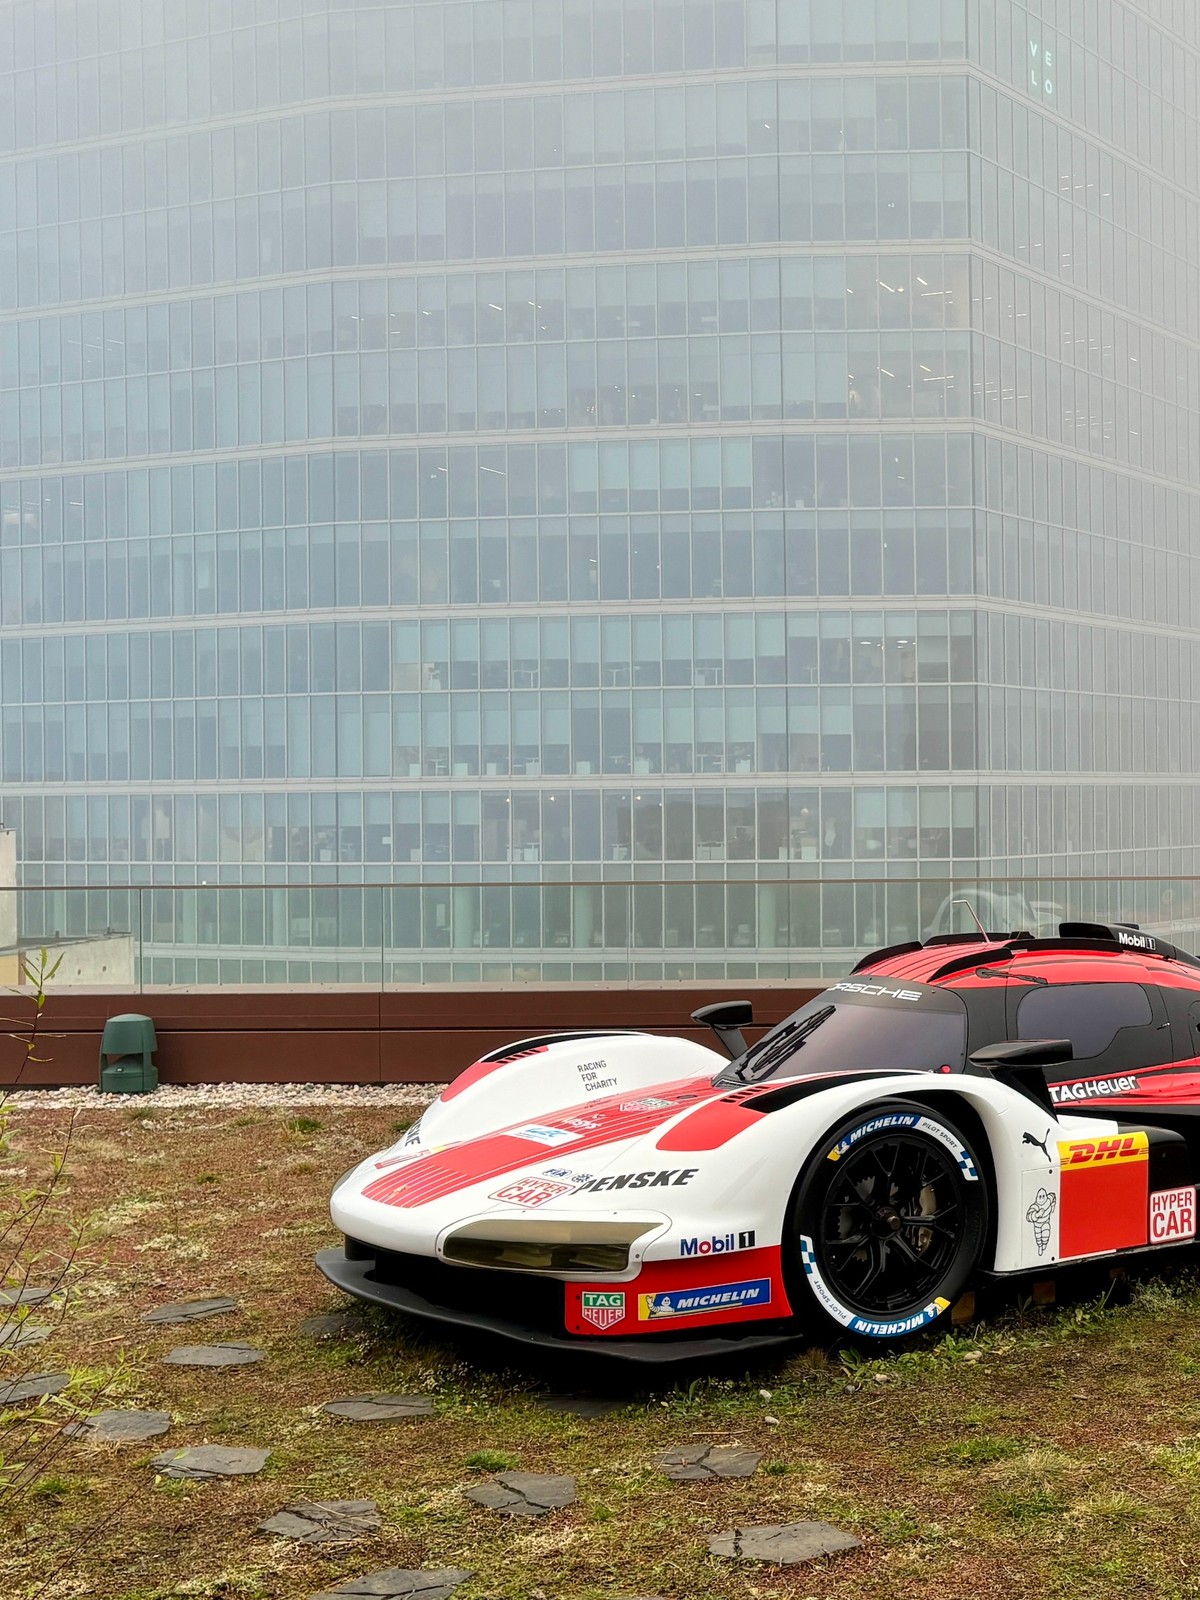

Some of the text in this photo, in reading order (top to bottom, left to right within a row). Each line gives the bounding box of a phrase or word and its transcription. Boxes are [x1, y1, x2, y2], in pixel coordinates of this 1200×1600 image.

[1118, 932, 1146, 948] Mobil
[577, 1060, 608, 1073] RACING
[581, 1072, 598, 1083] FOR
[585, 1077, 619, 1092] CHARITY
[850, 1115, 958, 1149] MICHELIN PILOT SPORT
[1068, 1137, 1141, 1164] DHL
[516, 1178, 568, 1195] HYPER
[569, 1168, 700, 1196] PENSKE
[496, 1185, 550, 1206] CAR
[1152, 1191, 1192, 1213] HYPER
[1152, 1207, 1192, 1238] CAR
[680, 1233, 735, 1256] Mobil
[586, 1294, 622, 1306] TAG
[676, 1287, 760, 1309] MICHELIN
[813, 1279, 848, 1320] PILOT SPORT
[584, 1309, 623, 1328] HEUER
[854, 1313, 924, 1335] MICHELIN
